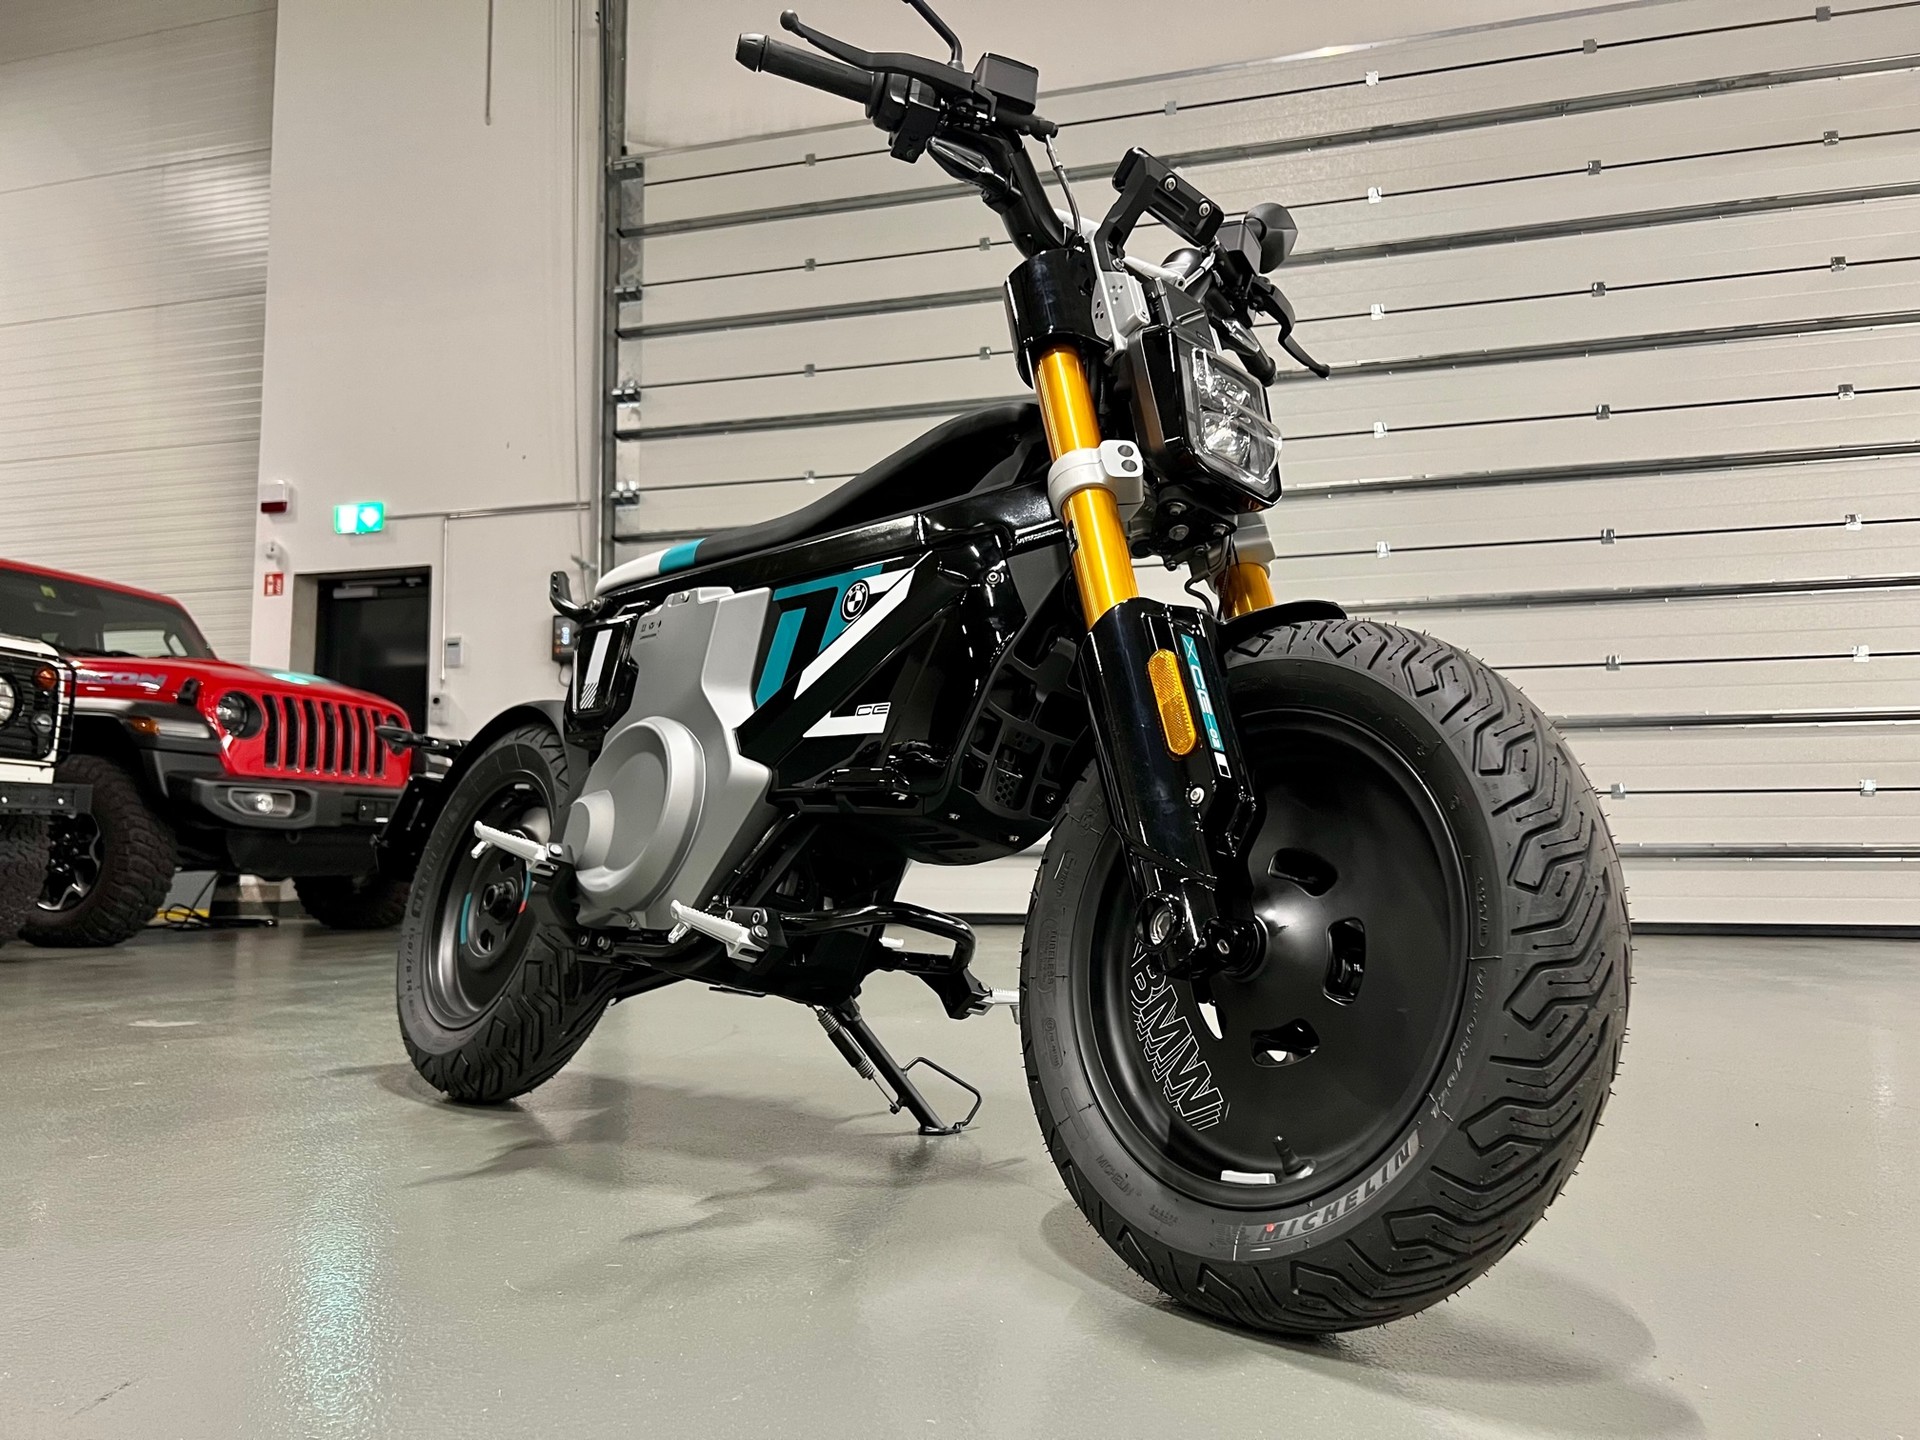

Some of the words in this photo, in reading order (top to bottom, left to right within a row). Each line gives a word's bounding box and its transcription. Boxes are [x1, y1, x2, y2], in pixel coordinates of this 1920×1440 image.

[856, 705, 890, 717] CE
[1046, 929, 1058, 985] TUBELESS
[1131, 953, 1225, 1118] BMW
[1096, 1152, 1135, 1196] MICHELIN
[1257, 1142, 1412, 1242] MICHELIN
